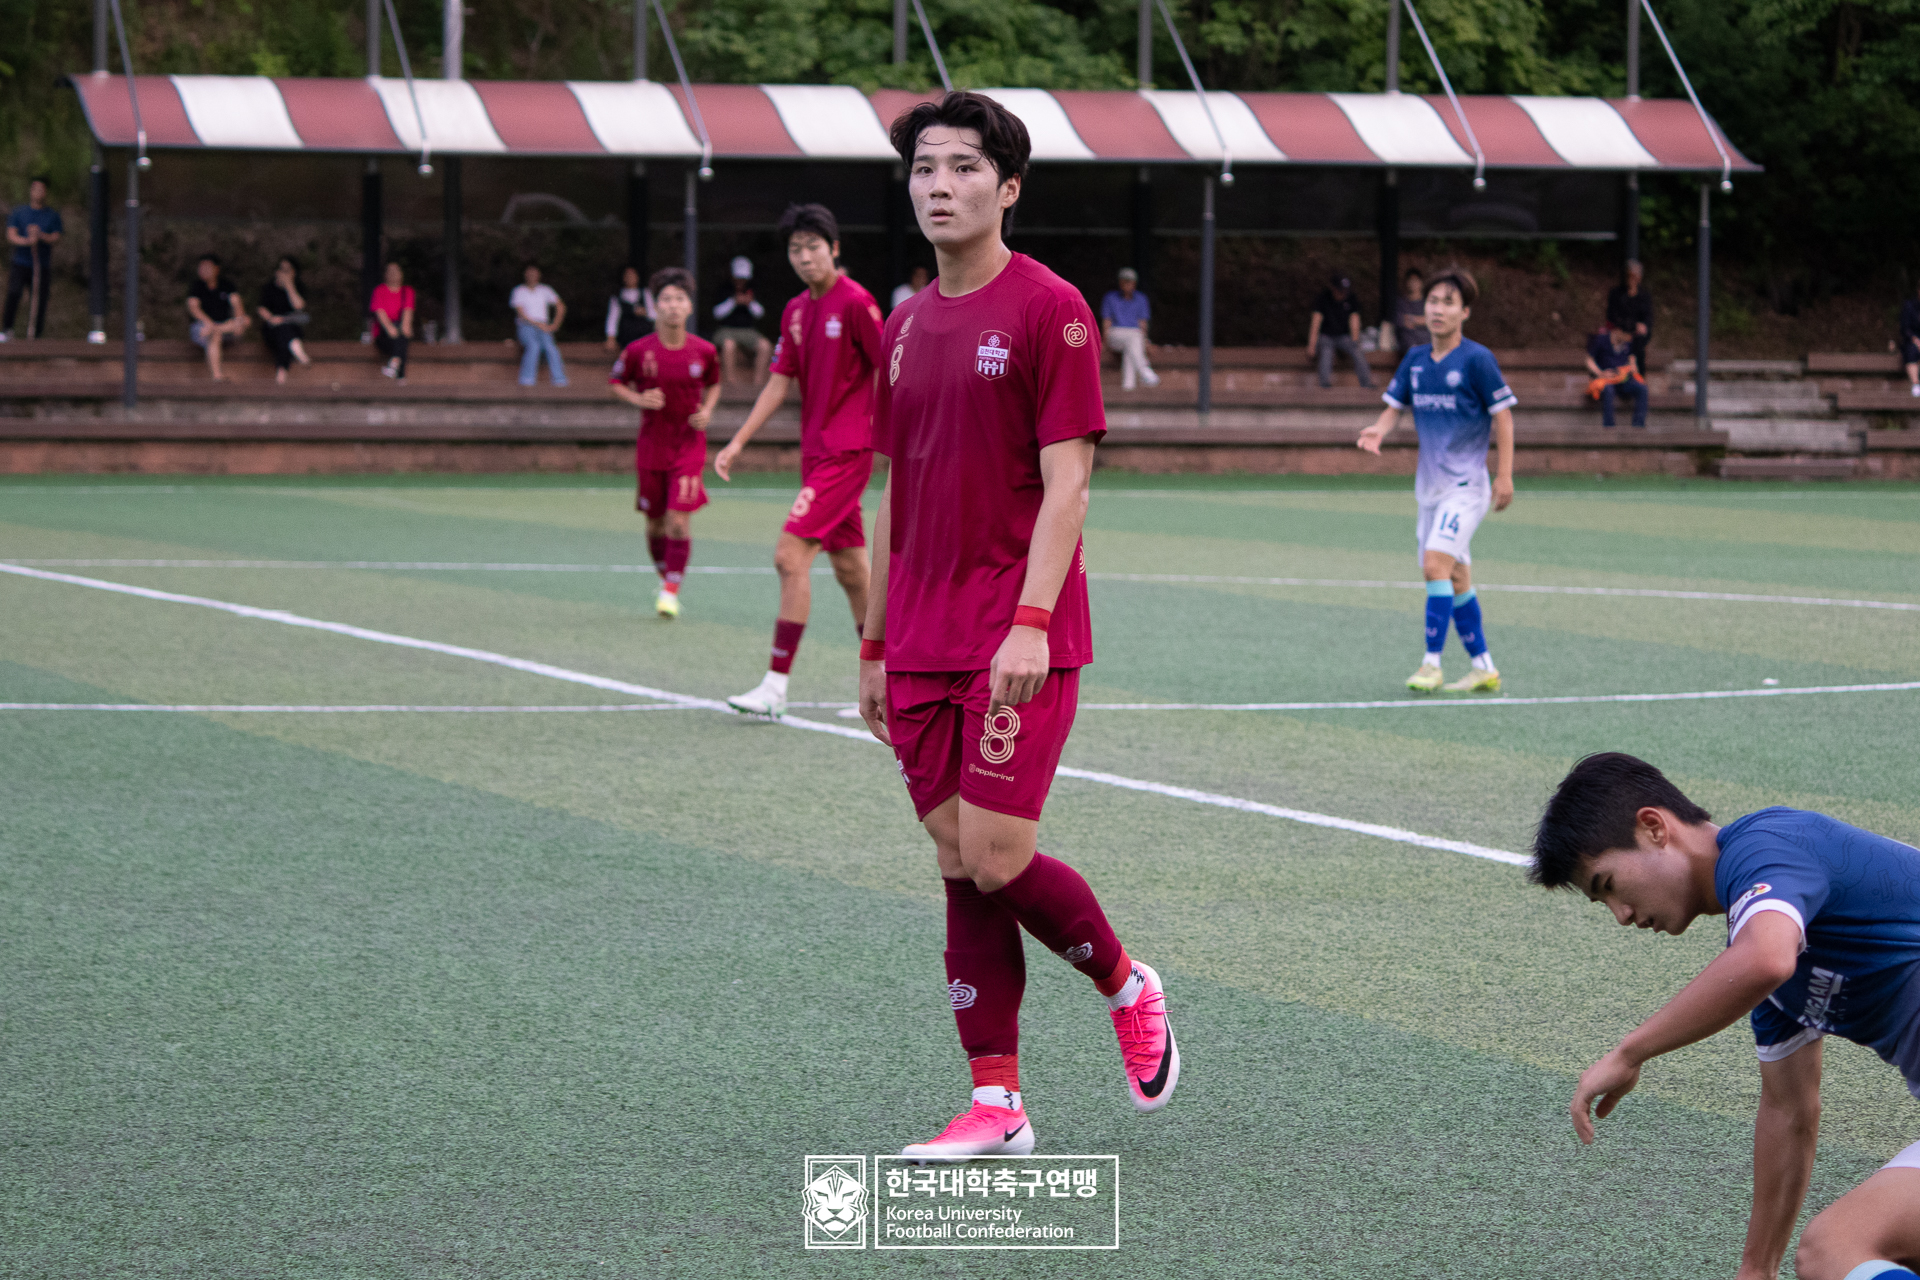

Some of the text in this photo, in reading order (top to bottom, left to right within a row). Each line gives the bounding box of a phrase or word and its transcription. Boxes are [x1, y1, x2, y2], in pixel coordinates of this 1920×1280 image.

[889, 344, 904, 386] 8
[1440, 511, 1459, 534] 14
[979, 705, 1021, 764] 8
[975, 766, 1015, 782] applerind
